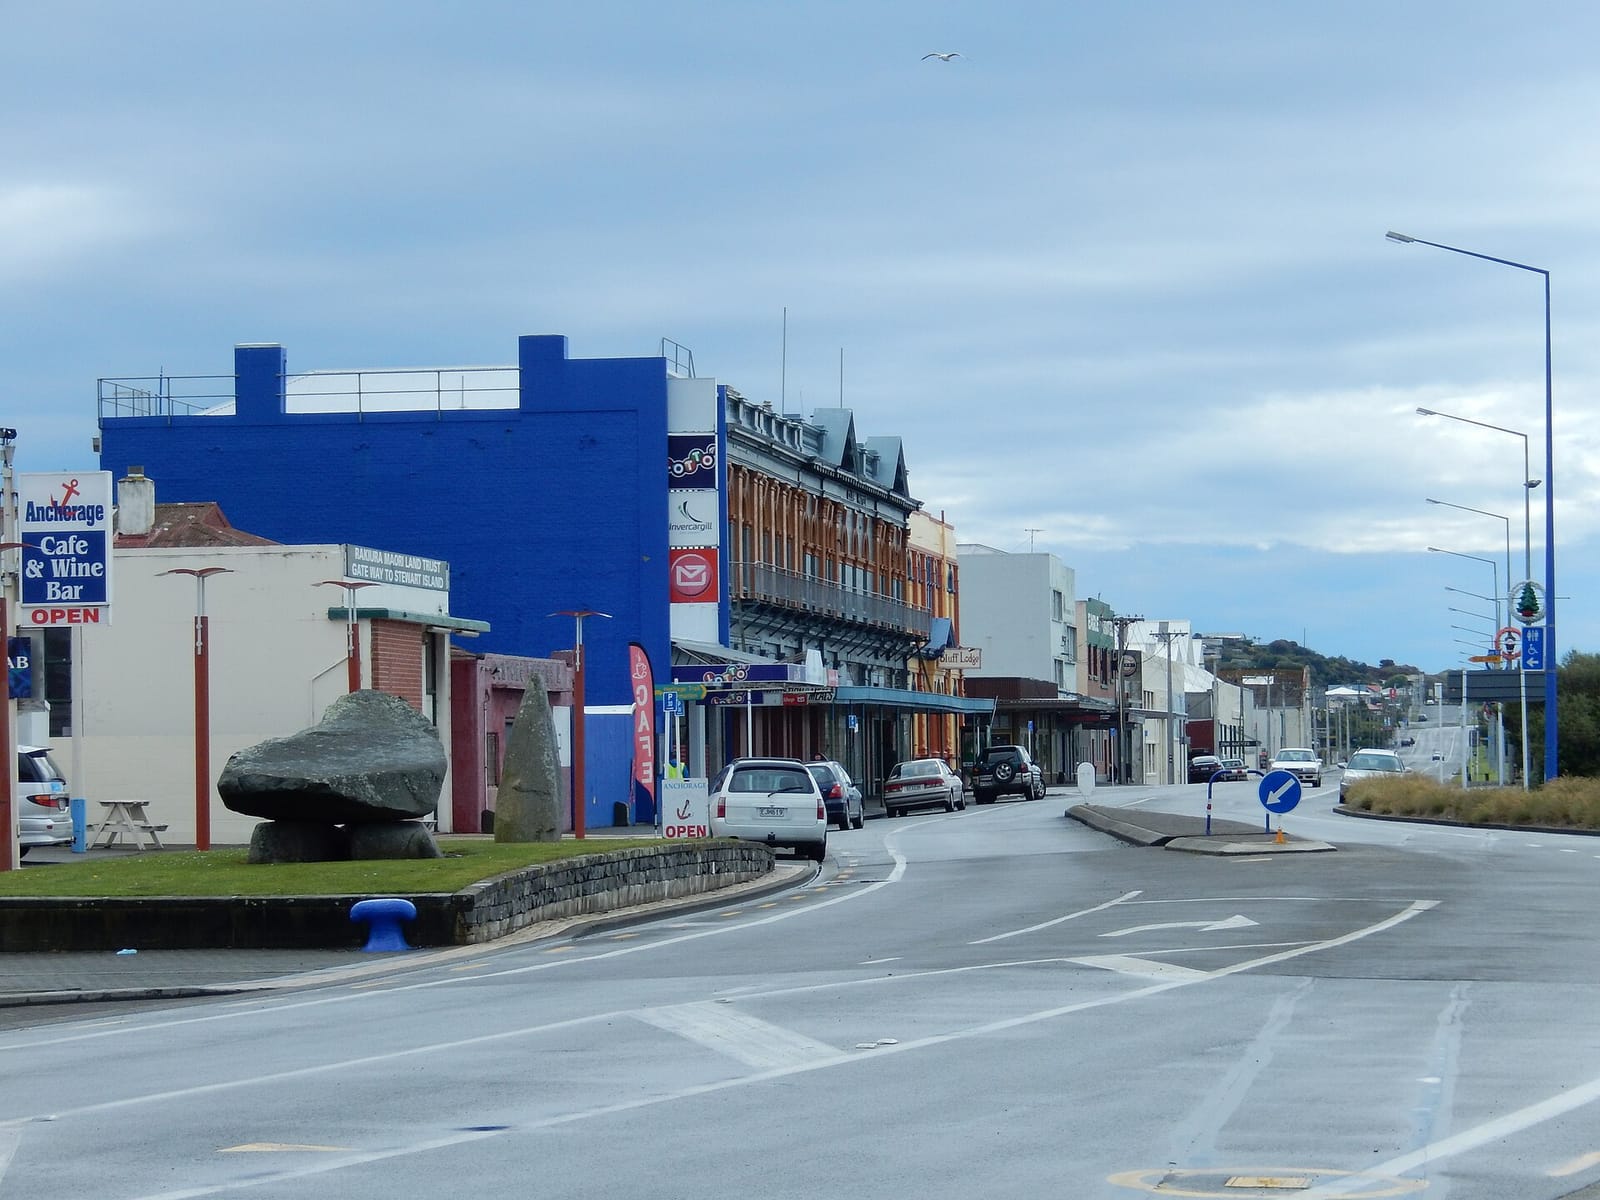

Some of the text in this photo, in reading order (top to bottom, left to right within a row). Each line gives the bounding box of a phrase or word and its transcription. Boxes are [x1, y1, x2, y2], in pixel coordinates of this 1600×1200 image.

[668, 449, 714, 476] OTTO
[26, 500, 104, 527] Anchorage
[669, 522, 712, 531] Invercargill
[40, 535, 88, 555] Cafe
[25, 557, 104, 579] & Wine
[354, 548, 441, 573] RAKIURA MAORI LAND TRUST
[352, 563, 444, 589] GATE WAY TO STEWART ISLAND
[46, 581, 84, 601] Bar
[31, 608, 100, 625] OPEN
[7, 656, 29, 669] AB
[664, 782, 707, 790] ANCHORAGE
[665, 825, 707, 838] OPEN
